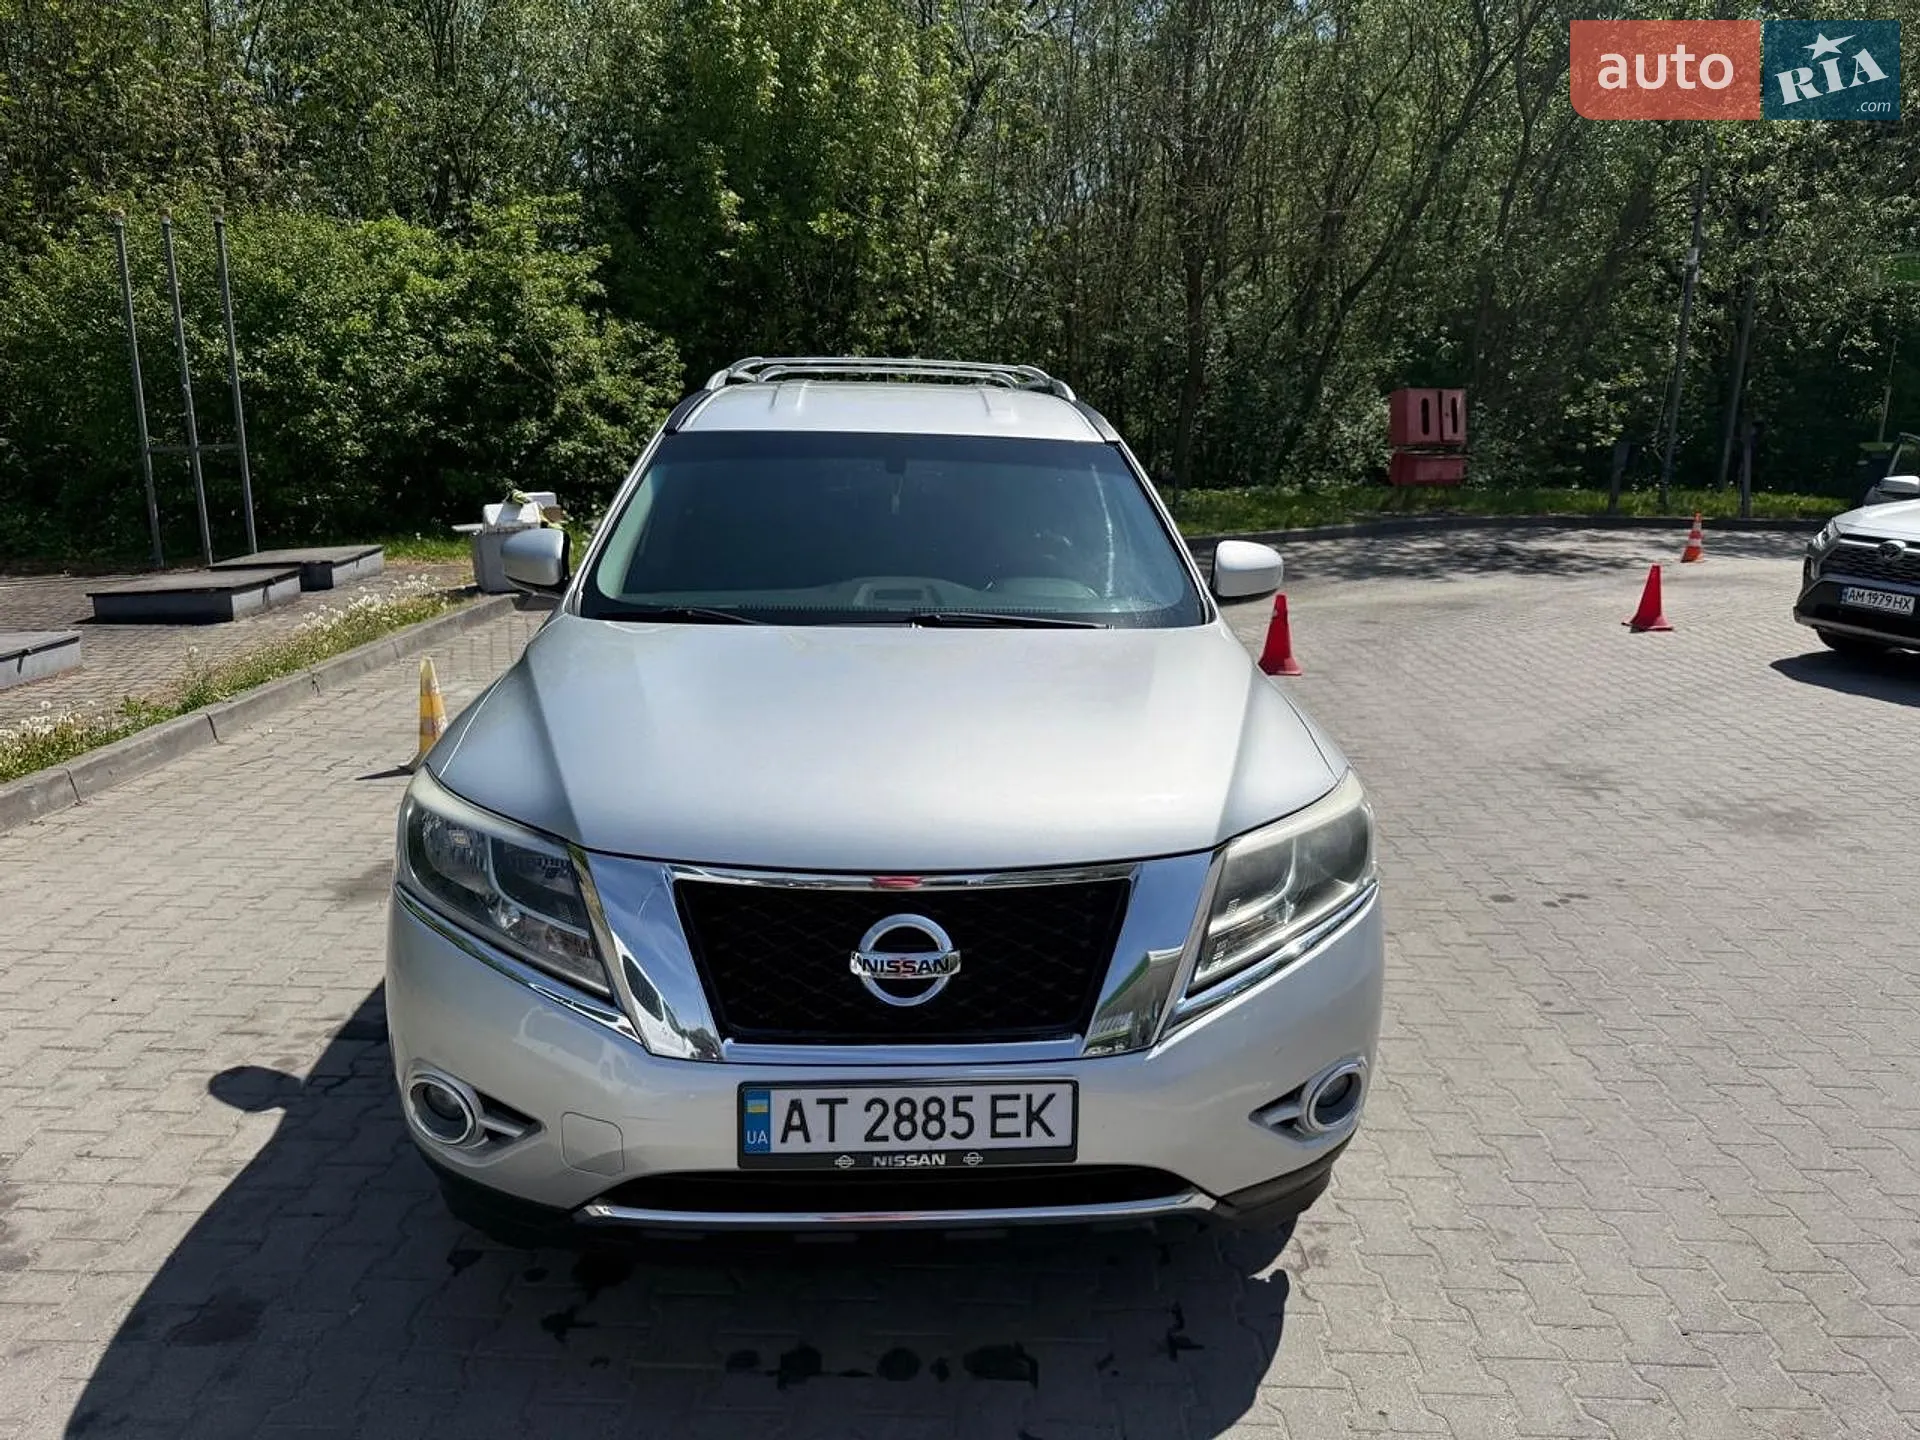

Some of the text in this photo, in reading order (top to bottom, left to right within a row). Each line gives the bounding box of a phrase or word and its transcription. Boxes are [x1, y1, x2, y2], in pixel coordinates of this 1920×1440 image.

[1848, 590, 1866, 603] AM
[1866, 592, 1893, 607] 1979
[1893, 595, 1911, 611] HX
[862, 958, 949, 973] NISSAN
[780, 1093, 1056, 1143] AT 2885 EK
[746, 1131, 768, 1144] UA
[873, 1154, 946, 1167] NISSAN
